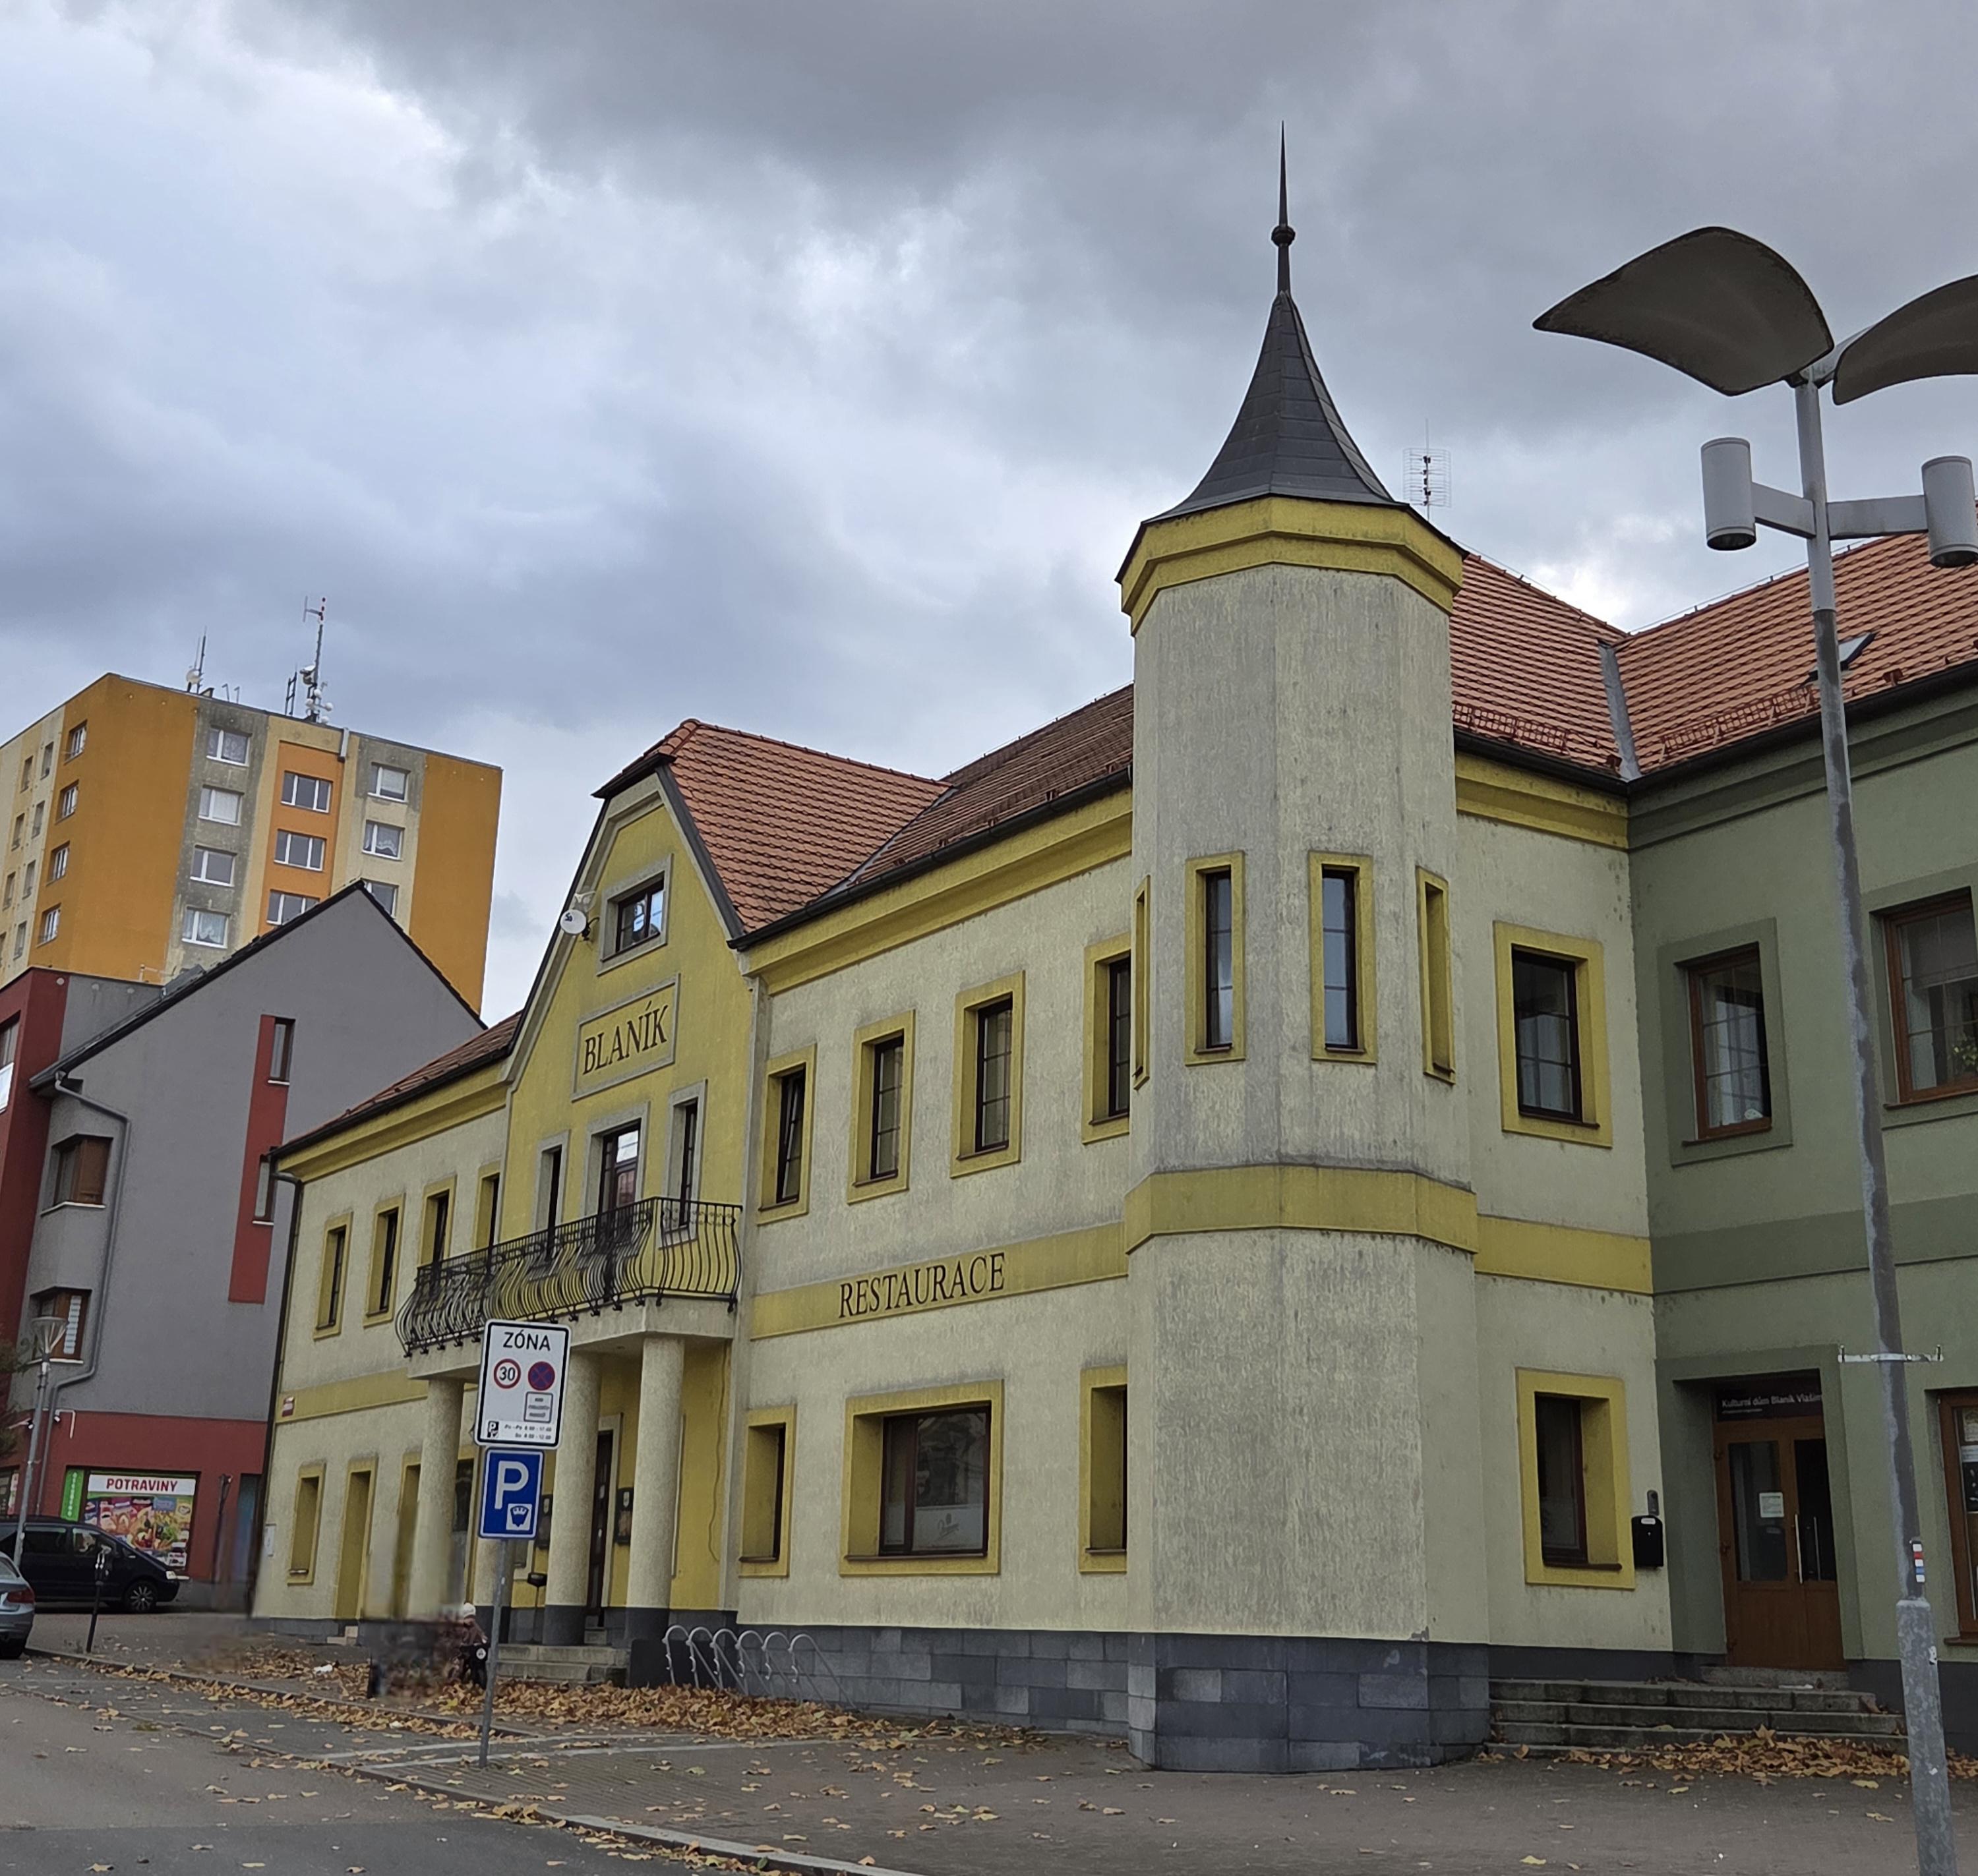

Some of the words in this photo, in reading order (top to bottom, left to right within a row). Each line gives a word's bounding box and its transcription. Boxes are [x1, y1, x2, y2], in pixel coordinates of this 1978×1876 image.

[582, 1000, 669, 1076] BLANÍK
[839, 1252, 1006, 1319] RESTAURACE
[502, 1329, 551, 1351] ZÓNA
[499, 1366, 516, 1381] 30
[106, 1478, 178, 1492] POTRAVINY
[494, 1460, 529, 1510] P
